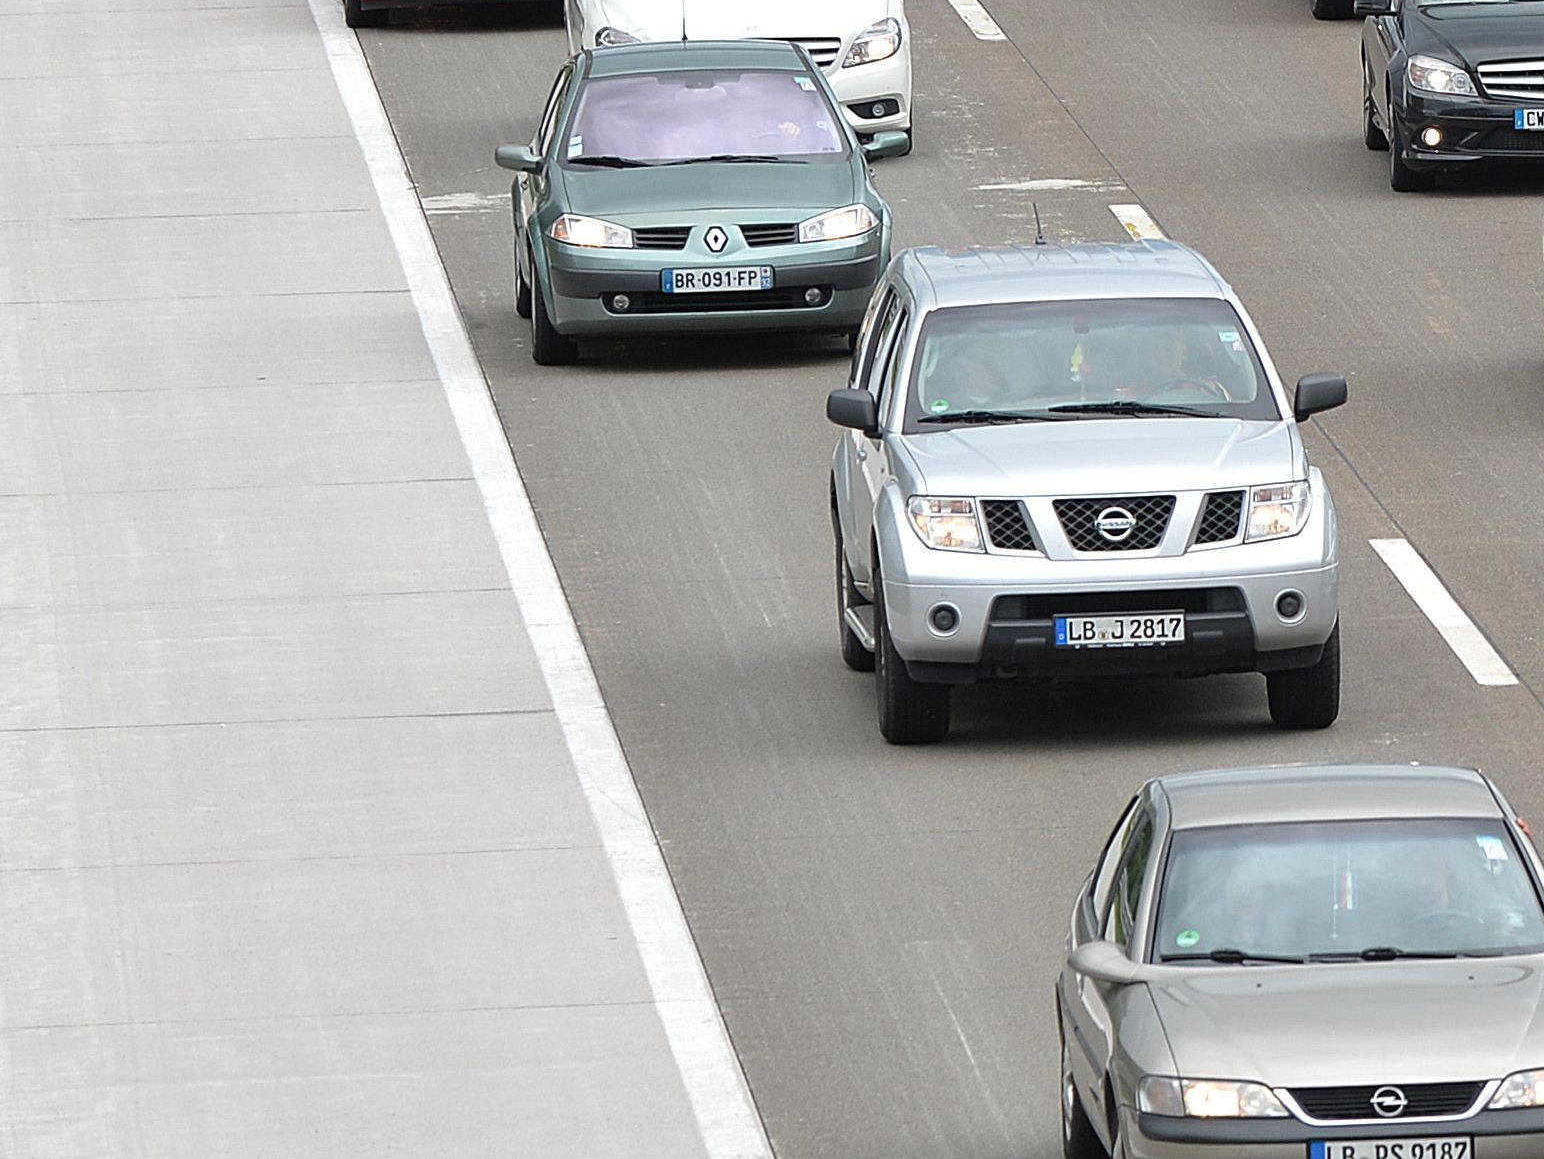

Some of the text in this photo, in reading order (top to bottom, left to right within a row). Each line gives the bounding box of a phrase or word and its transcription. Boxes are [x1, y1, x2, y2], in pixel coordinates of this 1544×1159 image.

[675, 270, 758, 289] BR-091-FP
[1069, 618, 1181, 641] LB J 2817
